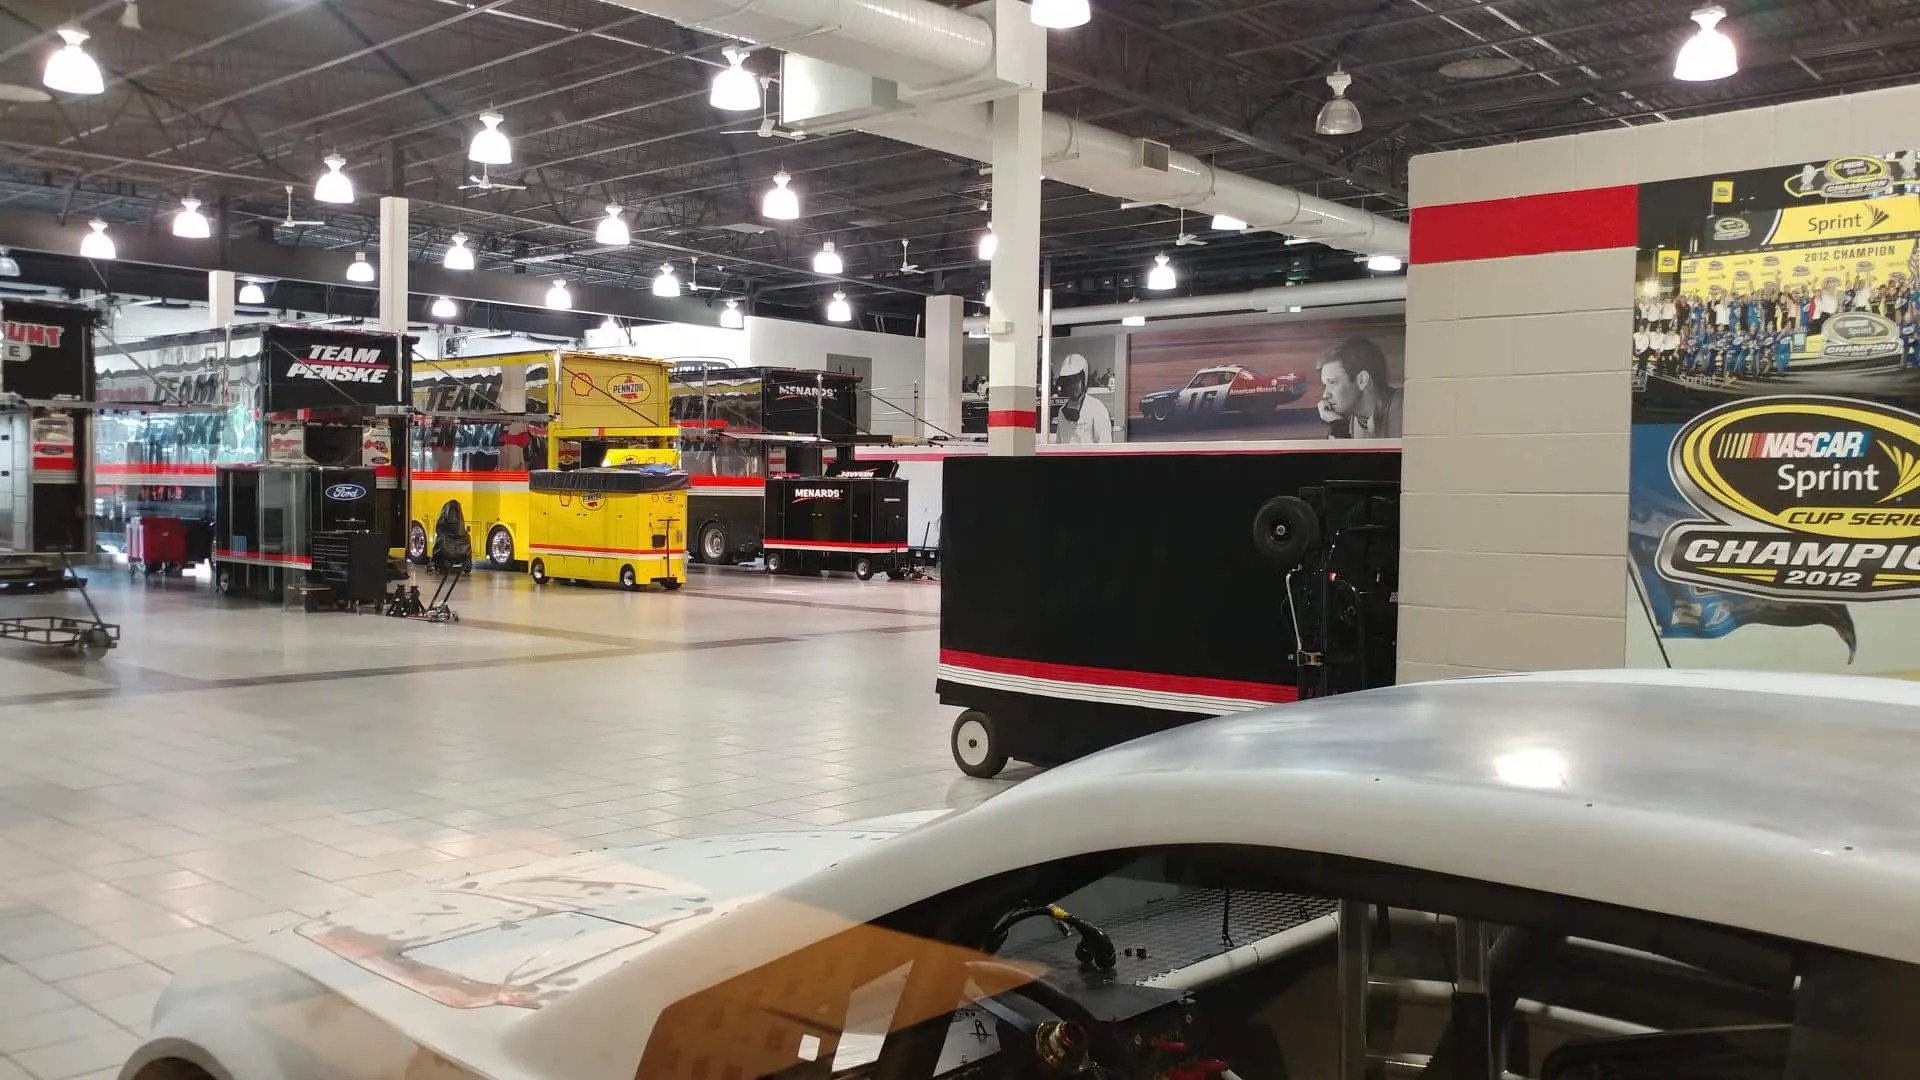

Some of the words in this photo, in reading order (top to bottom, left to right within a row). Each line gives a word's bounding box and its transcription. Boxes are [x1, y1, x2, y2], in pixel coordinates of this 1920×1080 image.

[1808, 213, 1862, 234] Sprint
[1805, 253, 1829, 262] 2012
[1833, 245, 1896, 260] CHAMPION
[0, 320, 64, 348] UNT
[309, 344, 381, 363] TEAM
[1826, 343, 1896, 354] CHAMPION
[286, 363, 388, 383] PENSKE
[1679, 375, 1716, 386] Sprint
[613, 384, 644, 393] PENNZOIL
[779, 386, 834, 397] MENARDS
[1762, 432, 1863, 458] NASCAR
[1777, 463, 1880, 498] Sprint
[333, 486, 359, 498] Ford
[795, 488, 840, 498] MENARDS
[1788, 512, 1844, 525] CUP
[1783, 570, 1862, 587] 2012
